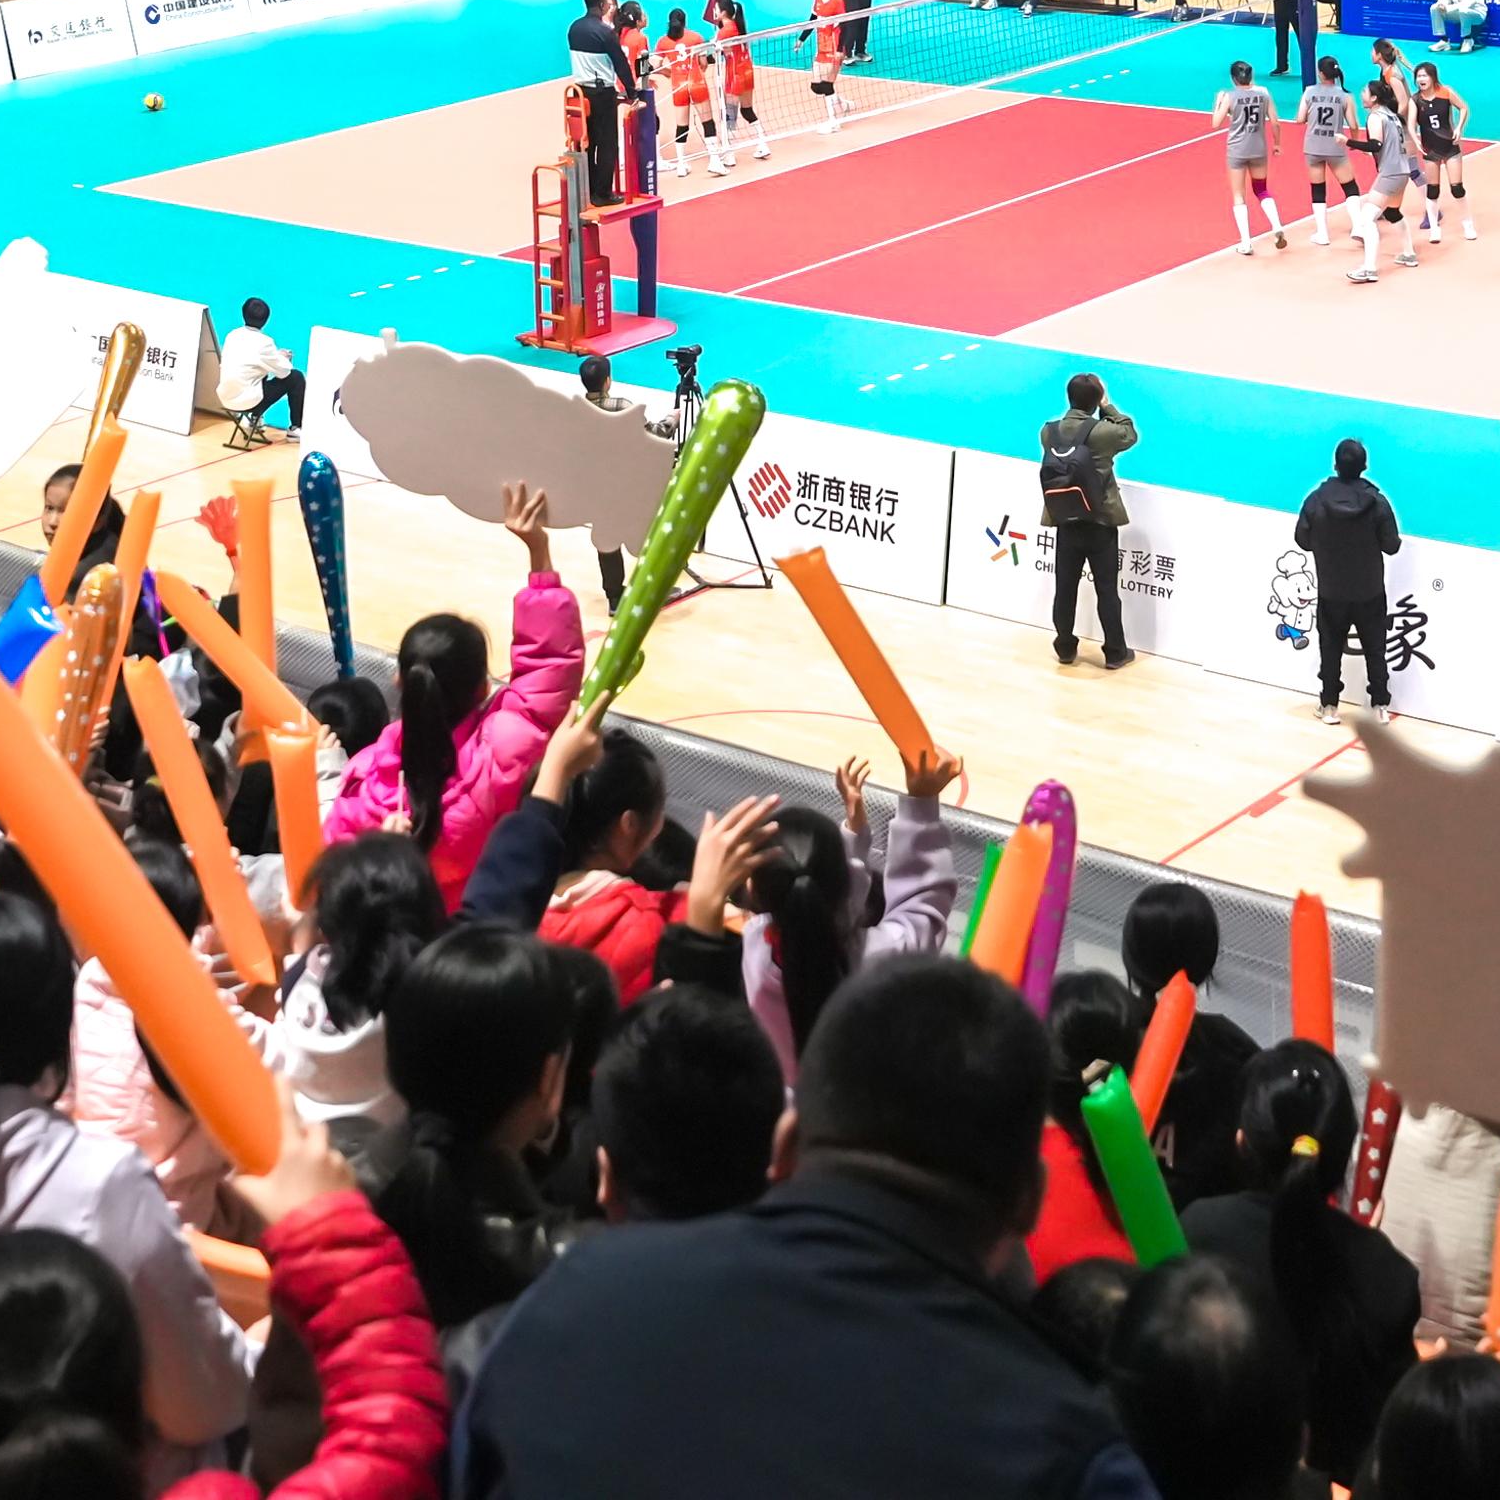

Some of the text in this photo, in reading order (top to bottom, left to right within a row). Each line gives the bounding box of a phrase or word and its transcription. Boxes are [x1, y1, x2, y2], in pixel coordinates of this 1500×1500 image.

[1243, 105, 1260, 125] 15
[1317, 106, 1334, 126] 12
[1428, 114, 1440, 129] 5
[154, 368, 174, 382] Bank
[796, 471, 898, 516] 浙商银行
[794, 503, 895, 544] CZBANK
[1121, 579, 1173, 599] LOTTERY
